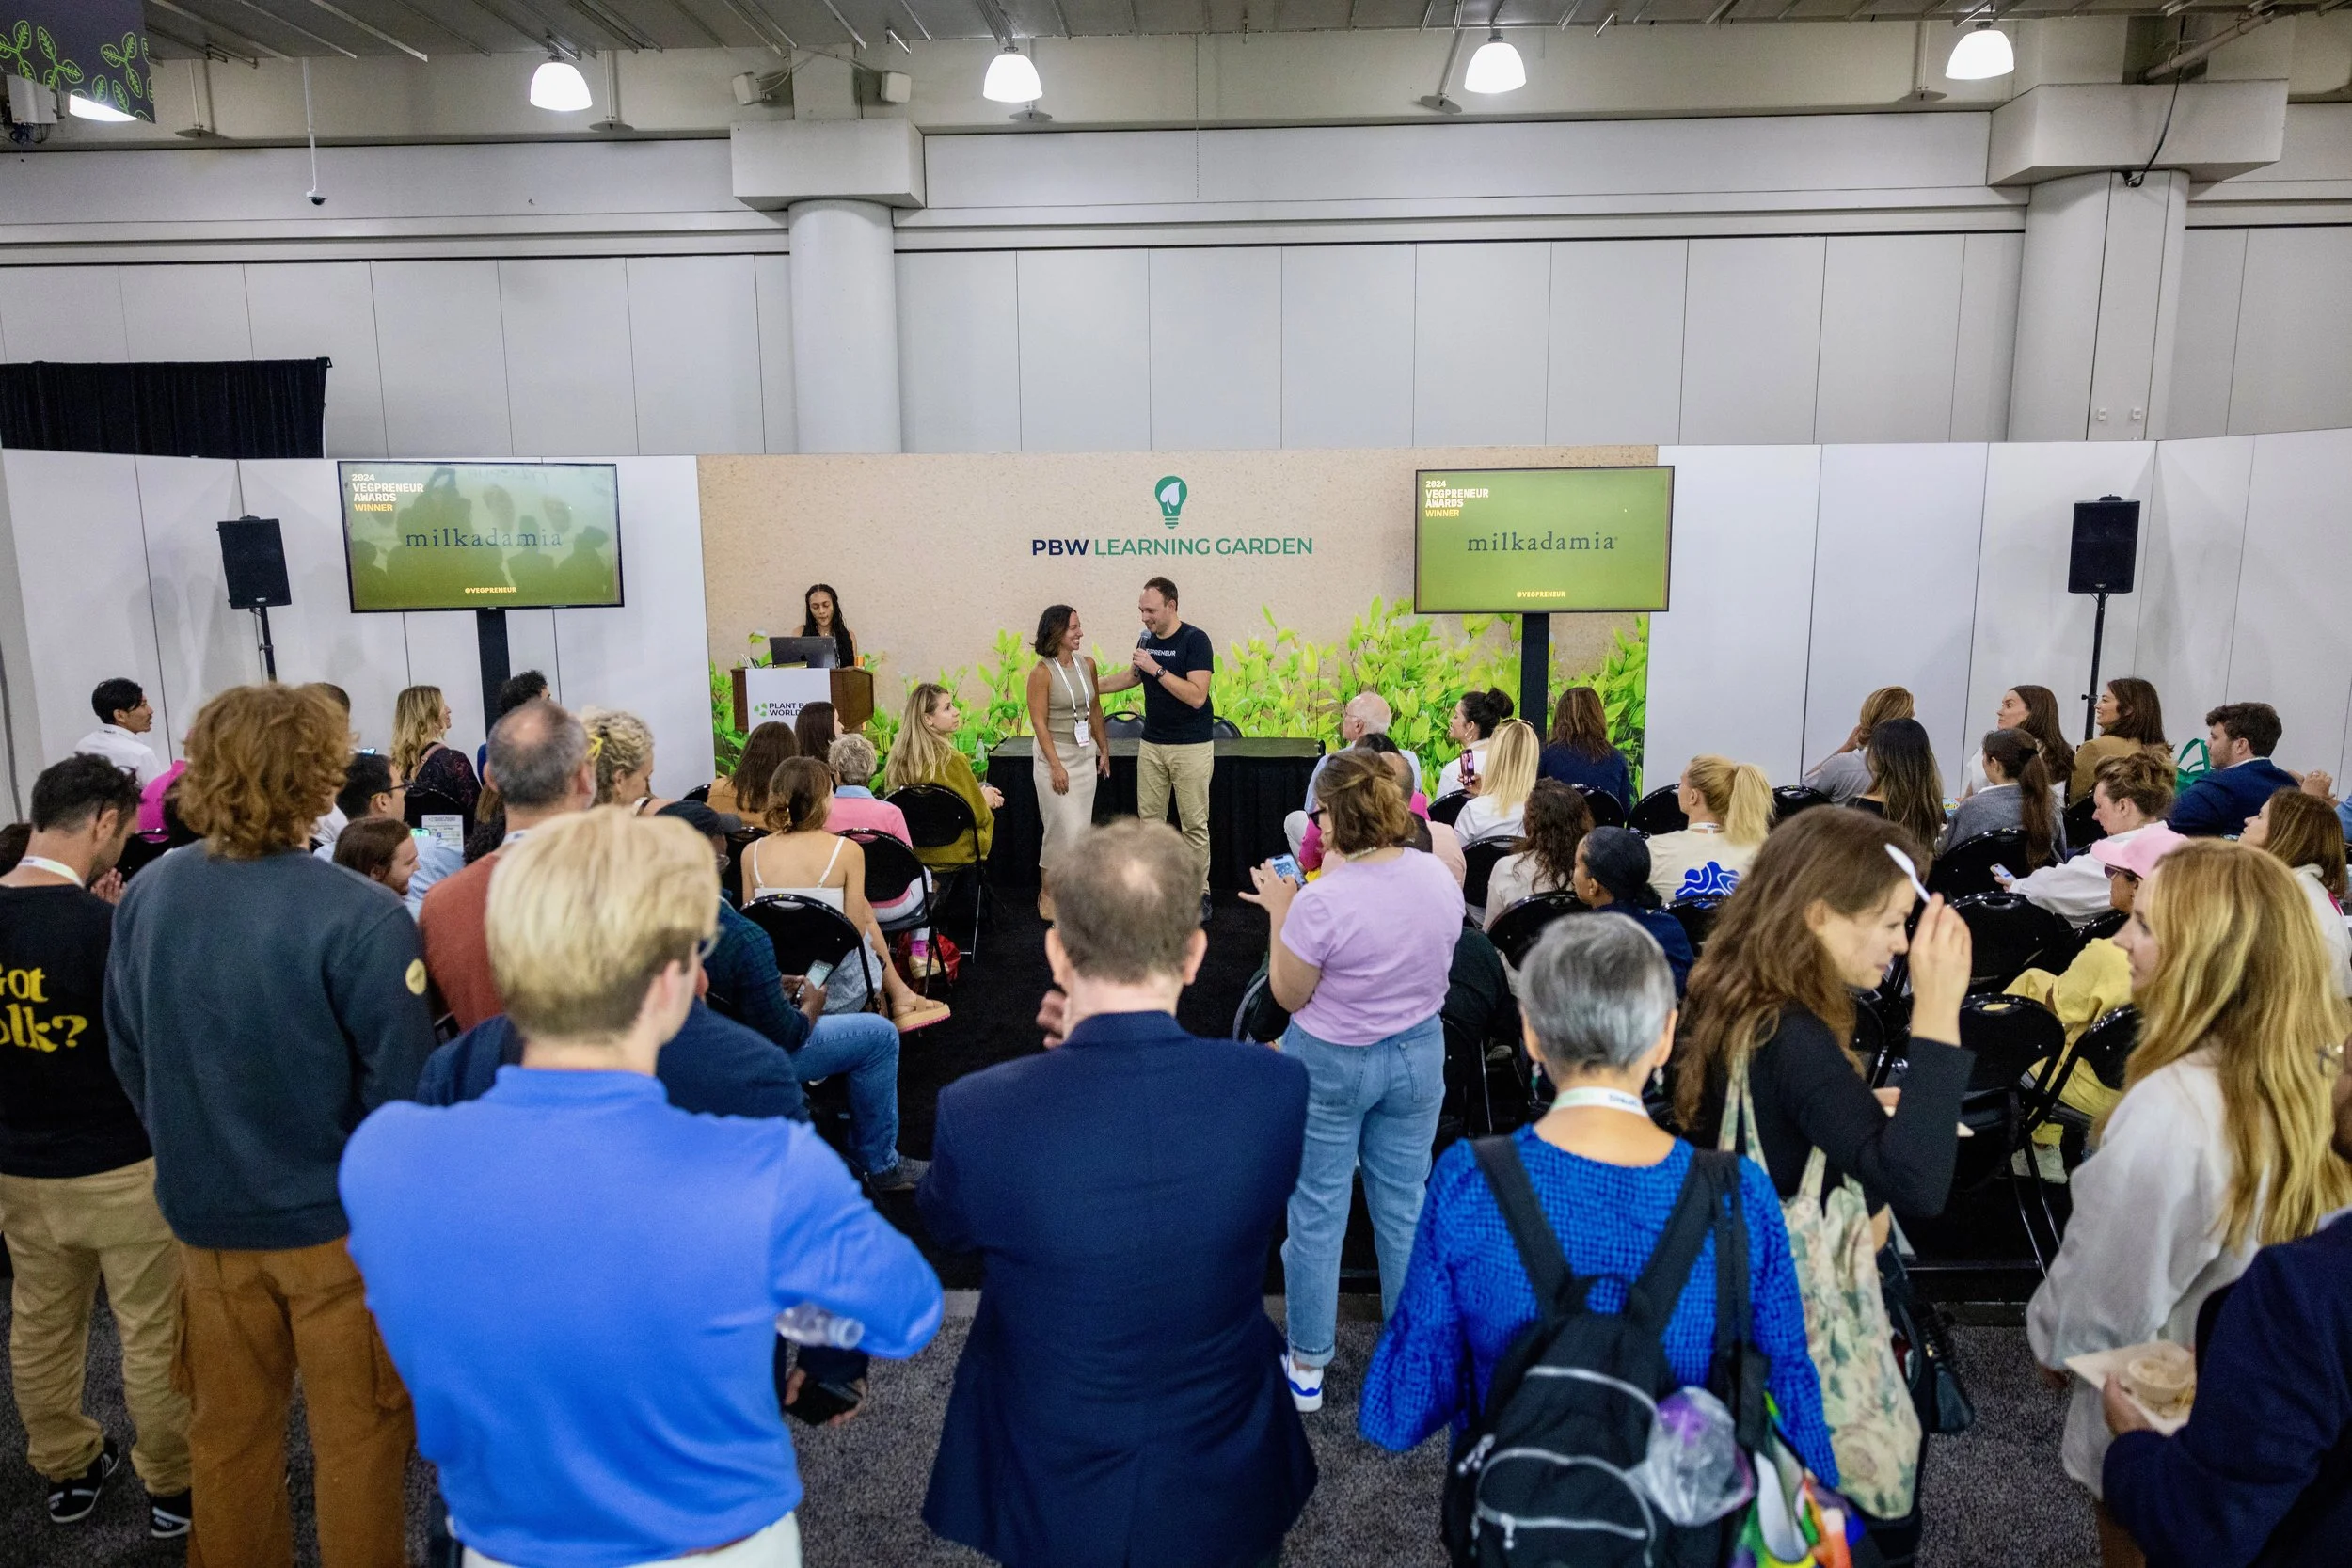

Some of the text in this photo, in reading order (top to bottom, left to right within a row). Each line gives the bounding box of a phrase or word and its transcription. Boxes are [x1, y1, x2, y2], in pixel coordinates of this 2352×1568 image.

[353, 483, 424, 493] VEGPRENEUR
[354, 493, 397, 502] AWARDS
[1425, 489, 1489, 499] VEGPRENEUR
[355, 503, 393, 512] WINNER
[1425, 499, 1464, 508] AWARDS
[1425, 509, 1460, 517] WINNER
[405, 528, 563, 547] milkadamia
[1032, 537, 1313, 556] PBW LEARNING GARDEN
